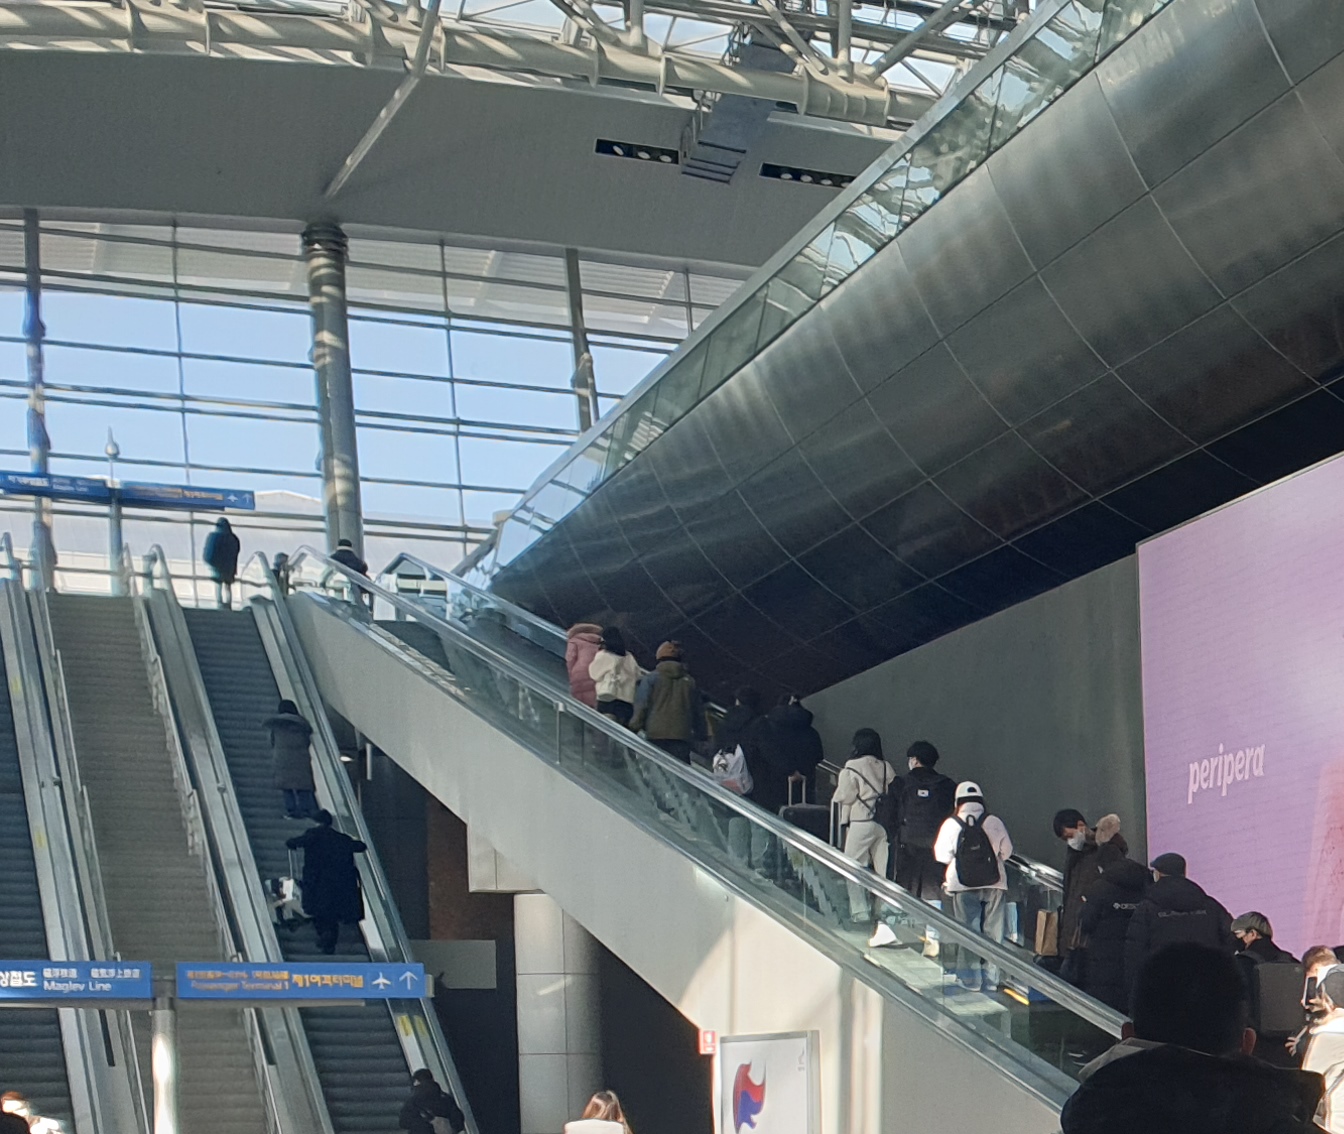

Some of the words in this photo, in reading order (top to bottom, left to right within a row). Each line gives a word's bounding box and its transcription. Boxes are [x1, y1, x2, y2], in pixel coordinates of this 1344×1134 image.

[1187, 742, 1266, 805] peripera
[43, 981, 85, 994] Maglev
[89, 980, 112, 992] Line
